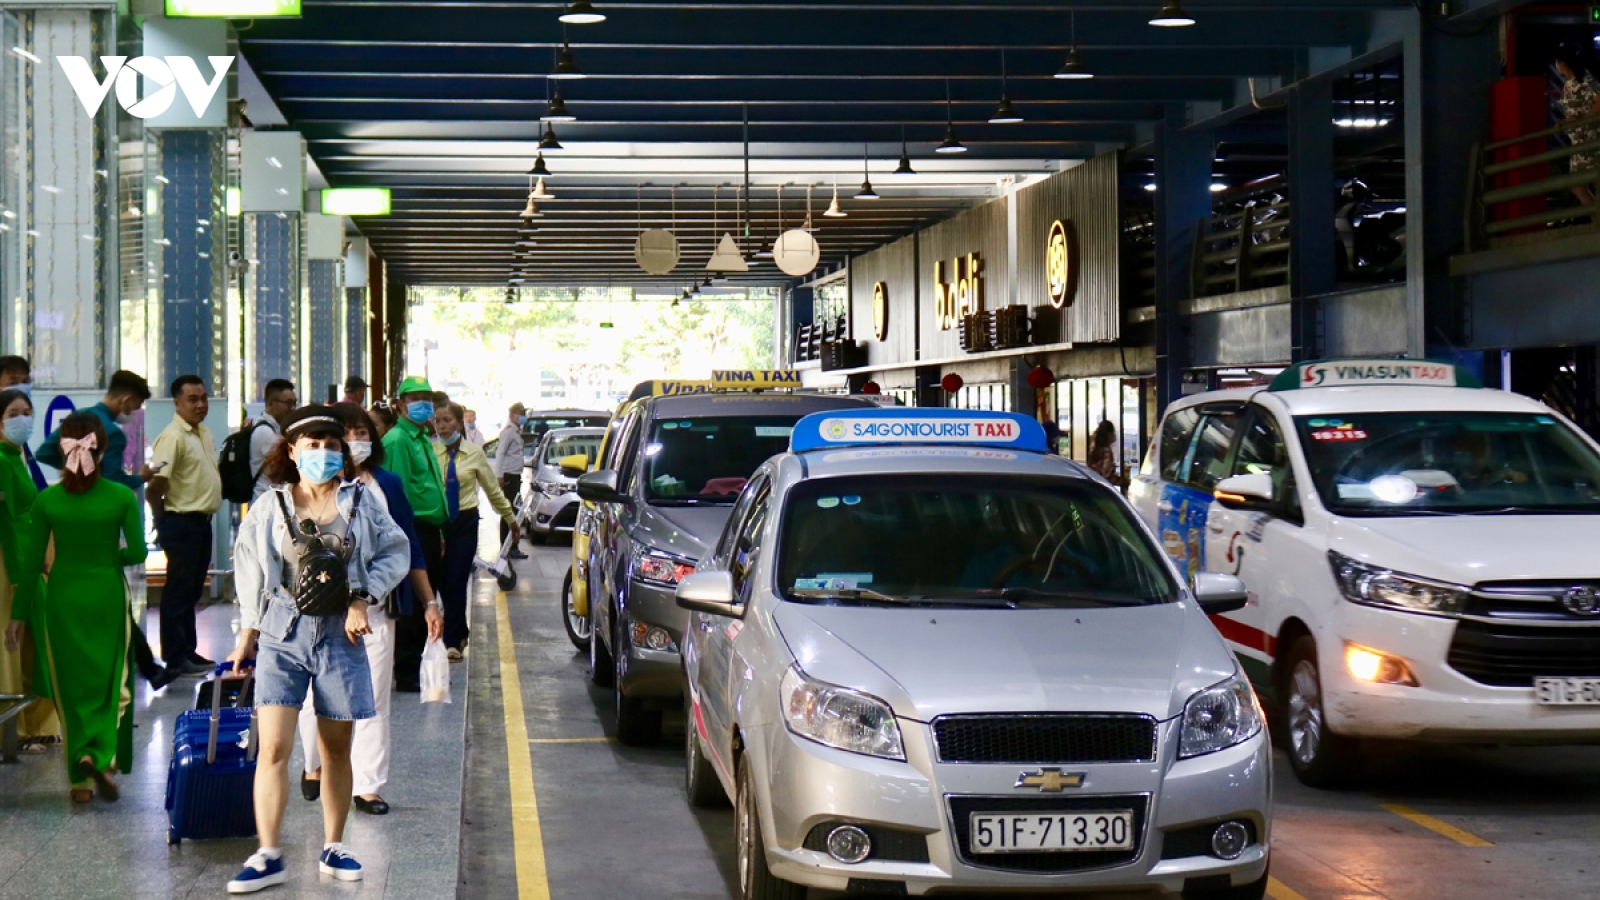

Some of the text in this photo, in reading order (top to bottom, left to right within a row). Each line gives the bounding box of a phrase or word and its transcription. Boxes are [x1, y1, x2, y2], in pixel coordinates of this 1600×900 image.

[934, 252, 978, 331] b.deli
[713, 370, 801, 382] VINA TAXI
[853, 422, 1012, 437] SAIGONTOURIST TAXI
[977, 816, 1127, 848] 51F-713.30
